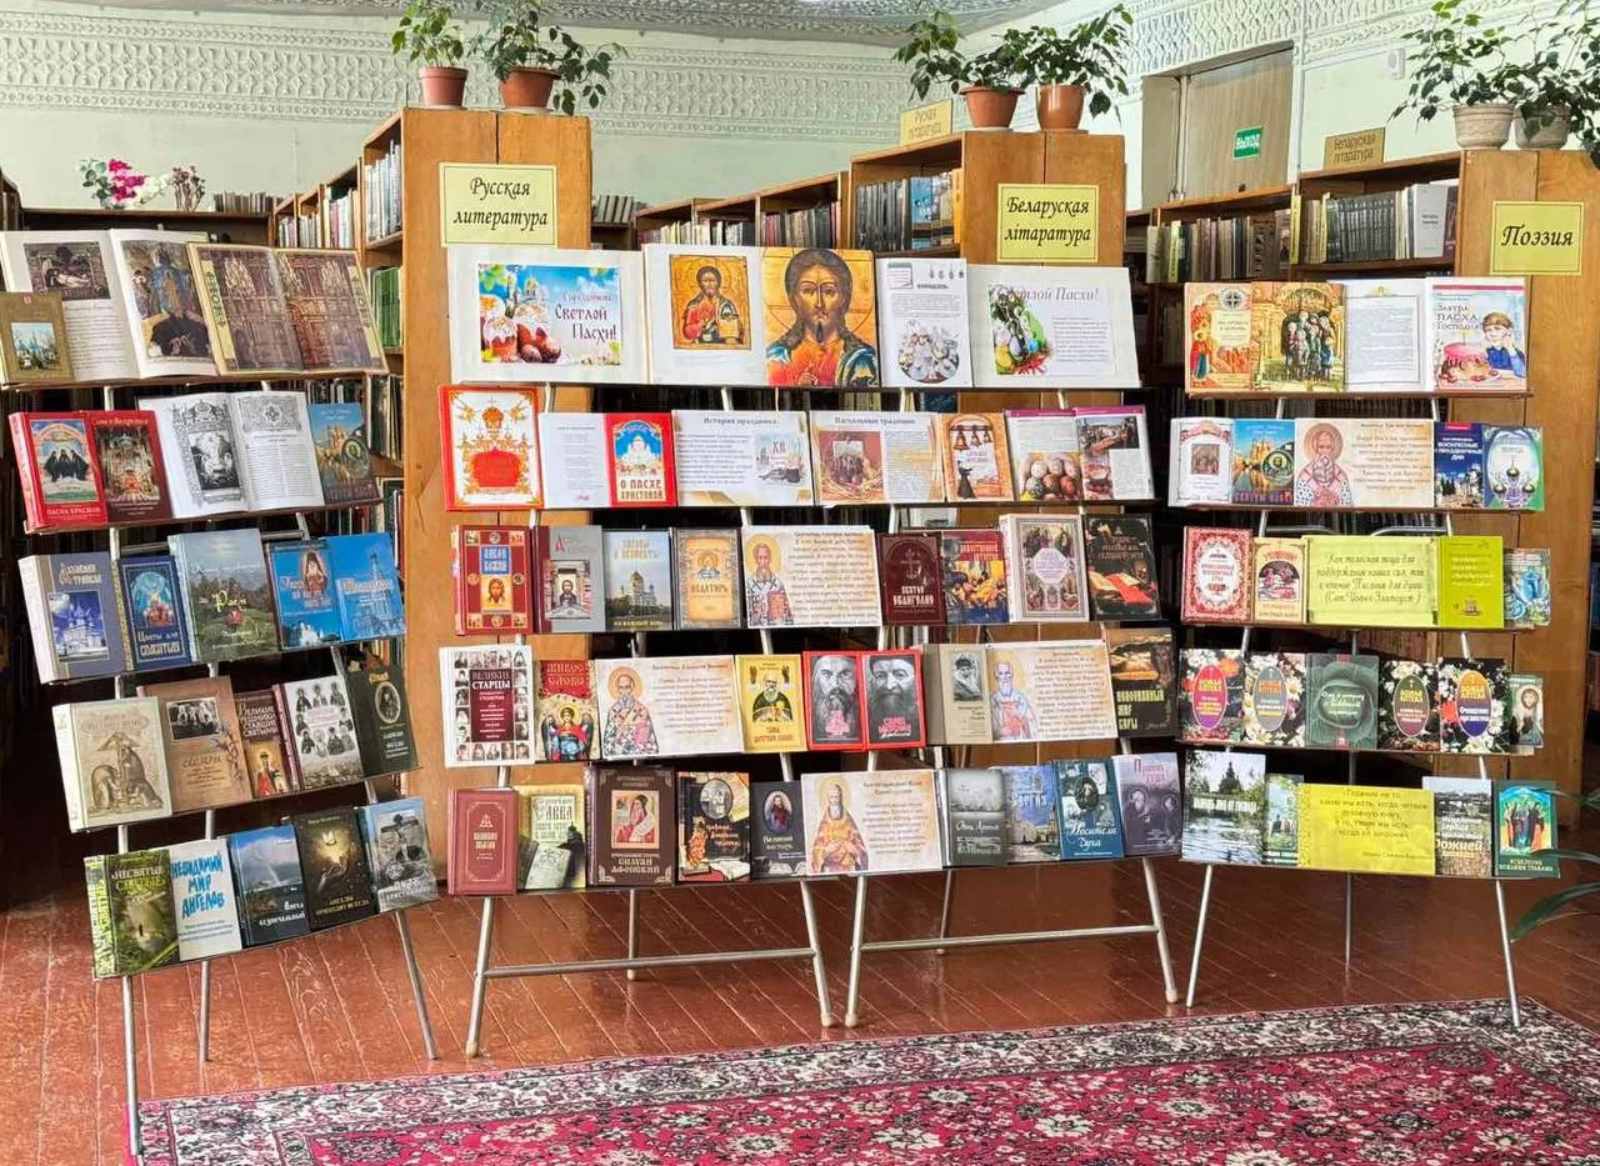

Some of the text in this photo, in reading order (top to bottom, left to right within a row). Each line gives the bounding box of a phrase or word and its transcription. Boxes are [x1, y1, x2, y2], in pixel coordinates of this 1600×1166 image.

[470, 177, 531, 200] Русская
[1007, 196, 1089, 218] Беларуская
[453, 208, 548, 233] литература
[1004, 224, 1091, 246] літаратура
[1500, 224, 1574, 247] Поэзия
[1055, 286, 1099, 301] Пасхи!
[555, 303, 607, 320] Светлой
[572, 323, 616, 344] Пасхи!
[704, 417, 735, 426] История
[630, 480, 662, 489] ПАСХЕ
[472, 680, 511, 690] СТАРЦЫ
[188, 874, 212, 893] МИР
[182, 891, 225, 919] АНГЕЛОВ
